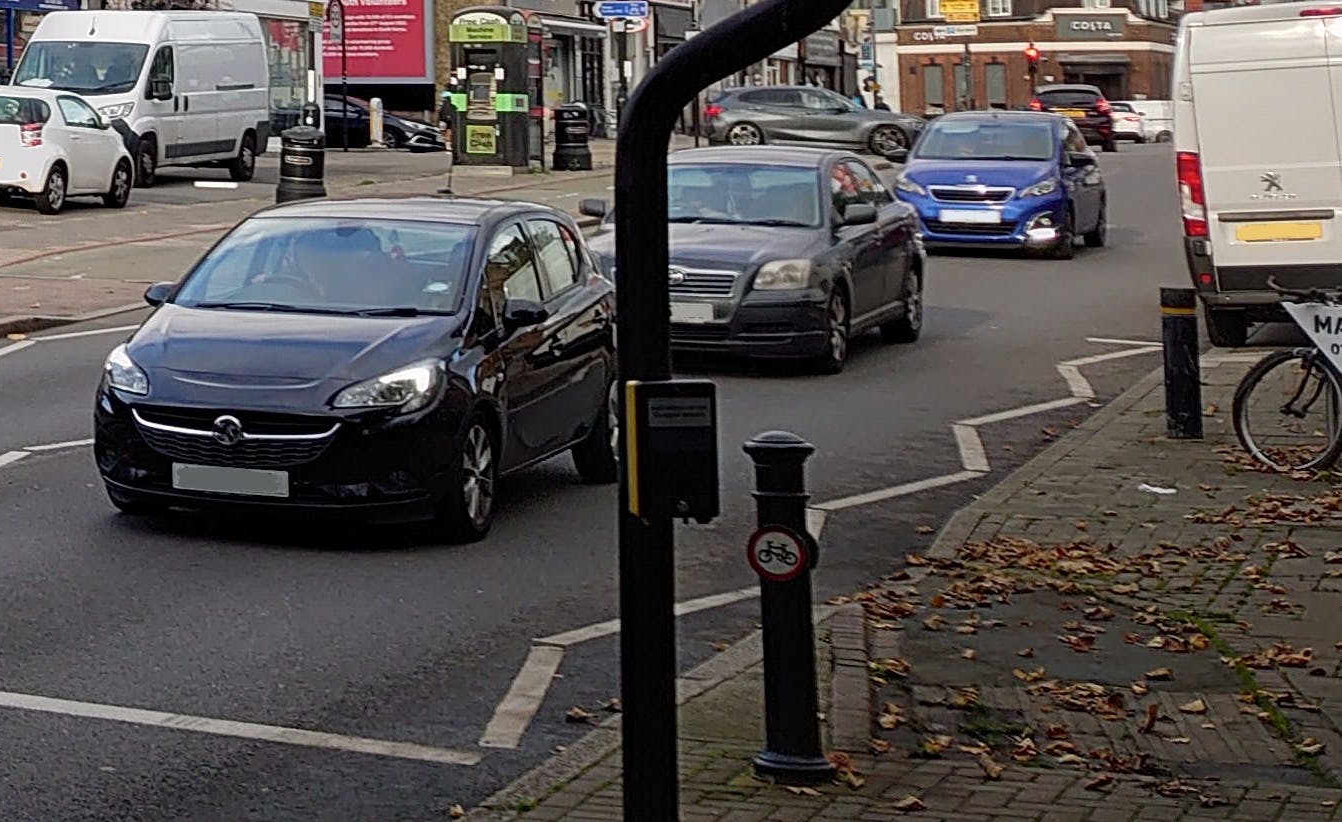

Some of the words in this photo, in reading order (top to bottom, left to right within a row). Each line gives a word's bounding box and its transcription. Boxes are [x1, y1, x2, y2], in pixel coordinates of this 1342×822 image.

[479, 17, 501, 25] Cash
[1070, 22, 1111, 31] COSTA
[471, 129, 492, 139] Free
[470, 139, 493, 148] Cash
